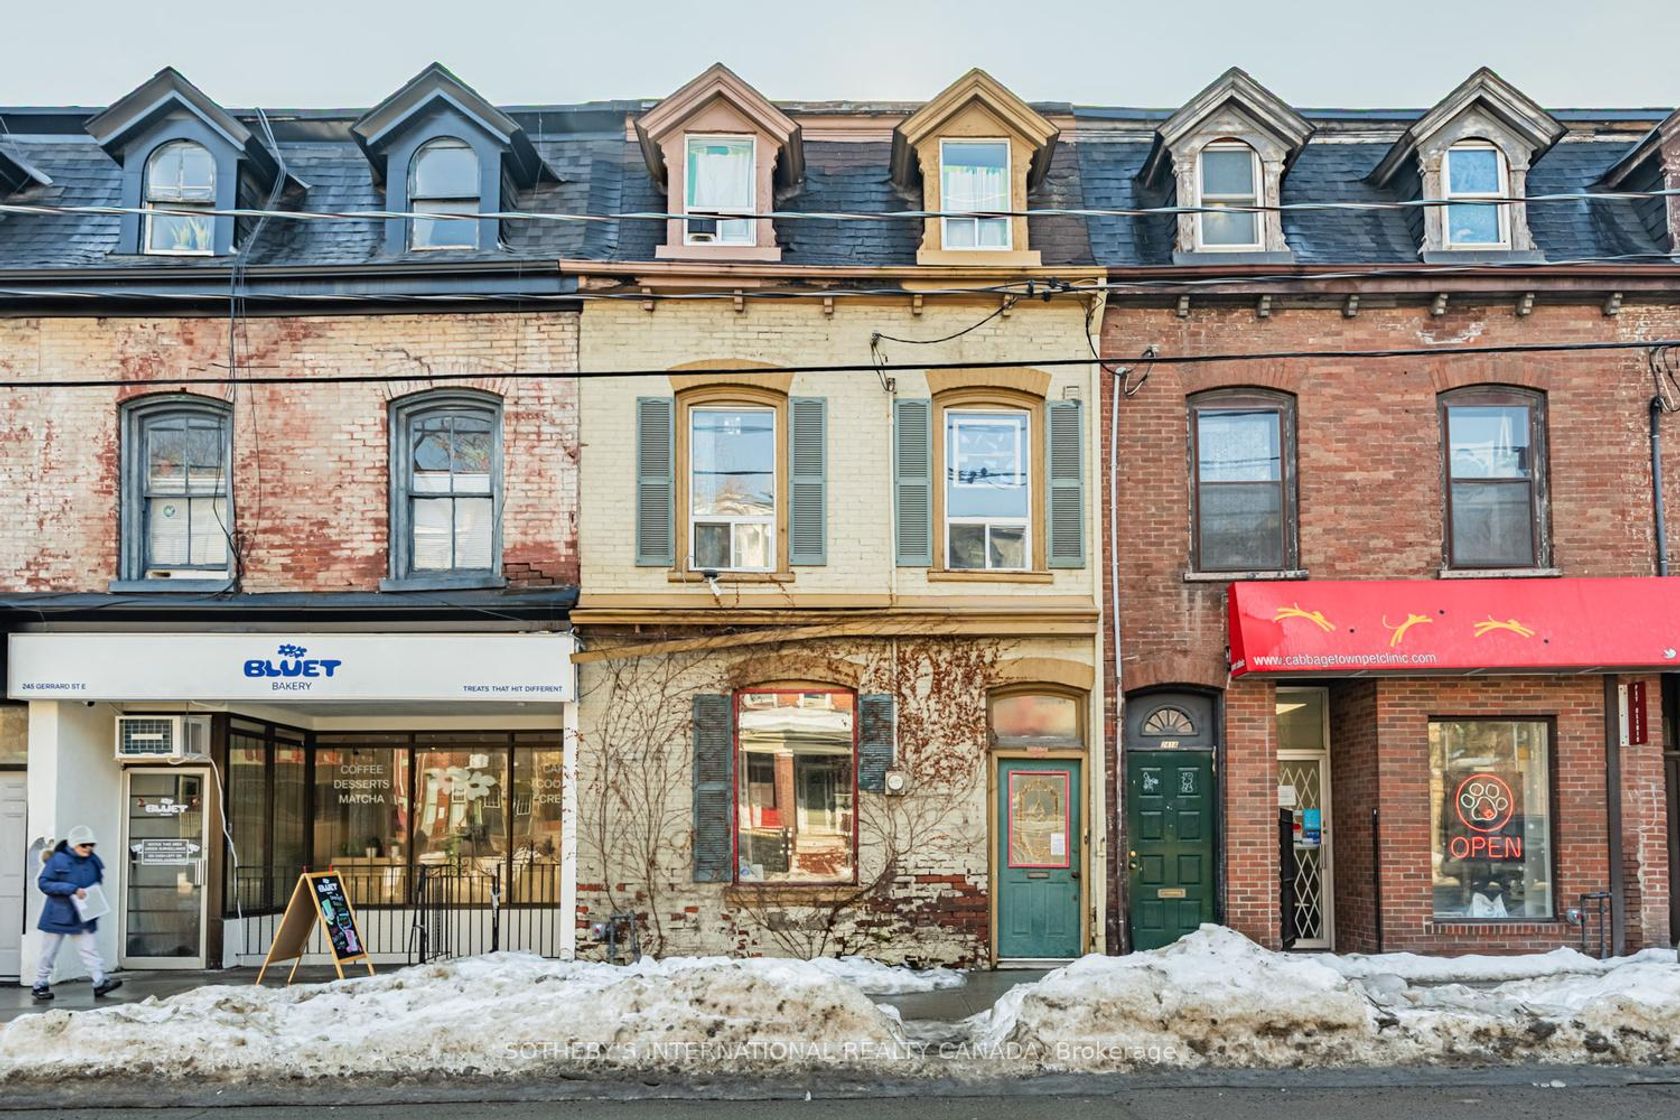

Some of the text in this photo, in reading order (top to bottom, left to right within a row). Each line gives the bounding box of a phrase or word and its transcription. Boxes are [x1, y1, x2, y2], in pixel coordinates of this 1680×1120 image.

[244, 659, 342, 677] BLUET
[272, 682, 312, 691] BAKERY
[463, 685, 563, 693] TREATS THAT HIT DIFFERENT
[340, 764, 384, 775] COFFEE
[333, 779, 390, 790] DESSERTS
[338, 794, 385, 804] MATCHA
[1450, 836, 1521, 859] OPEN
